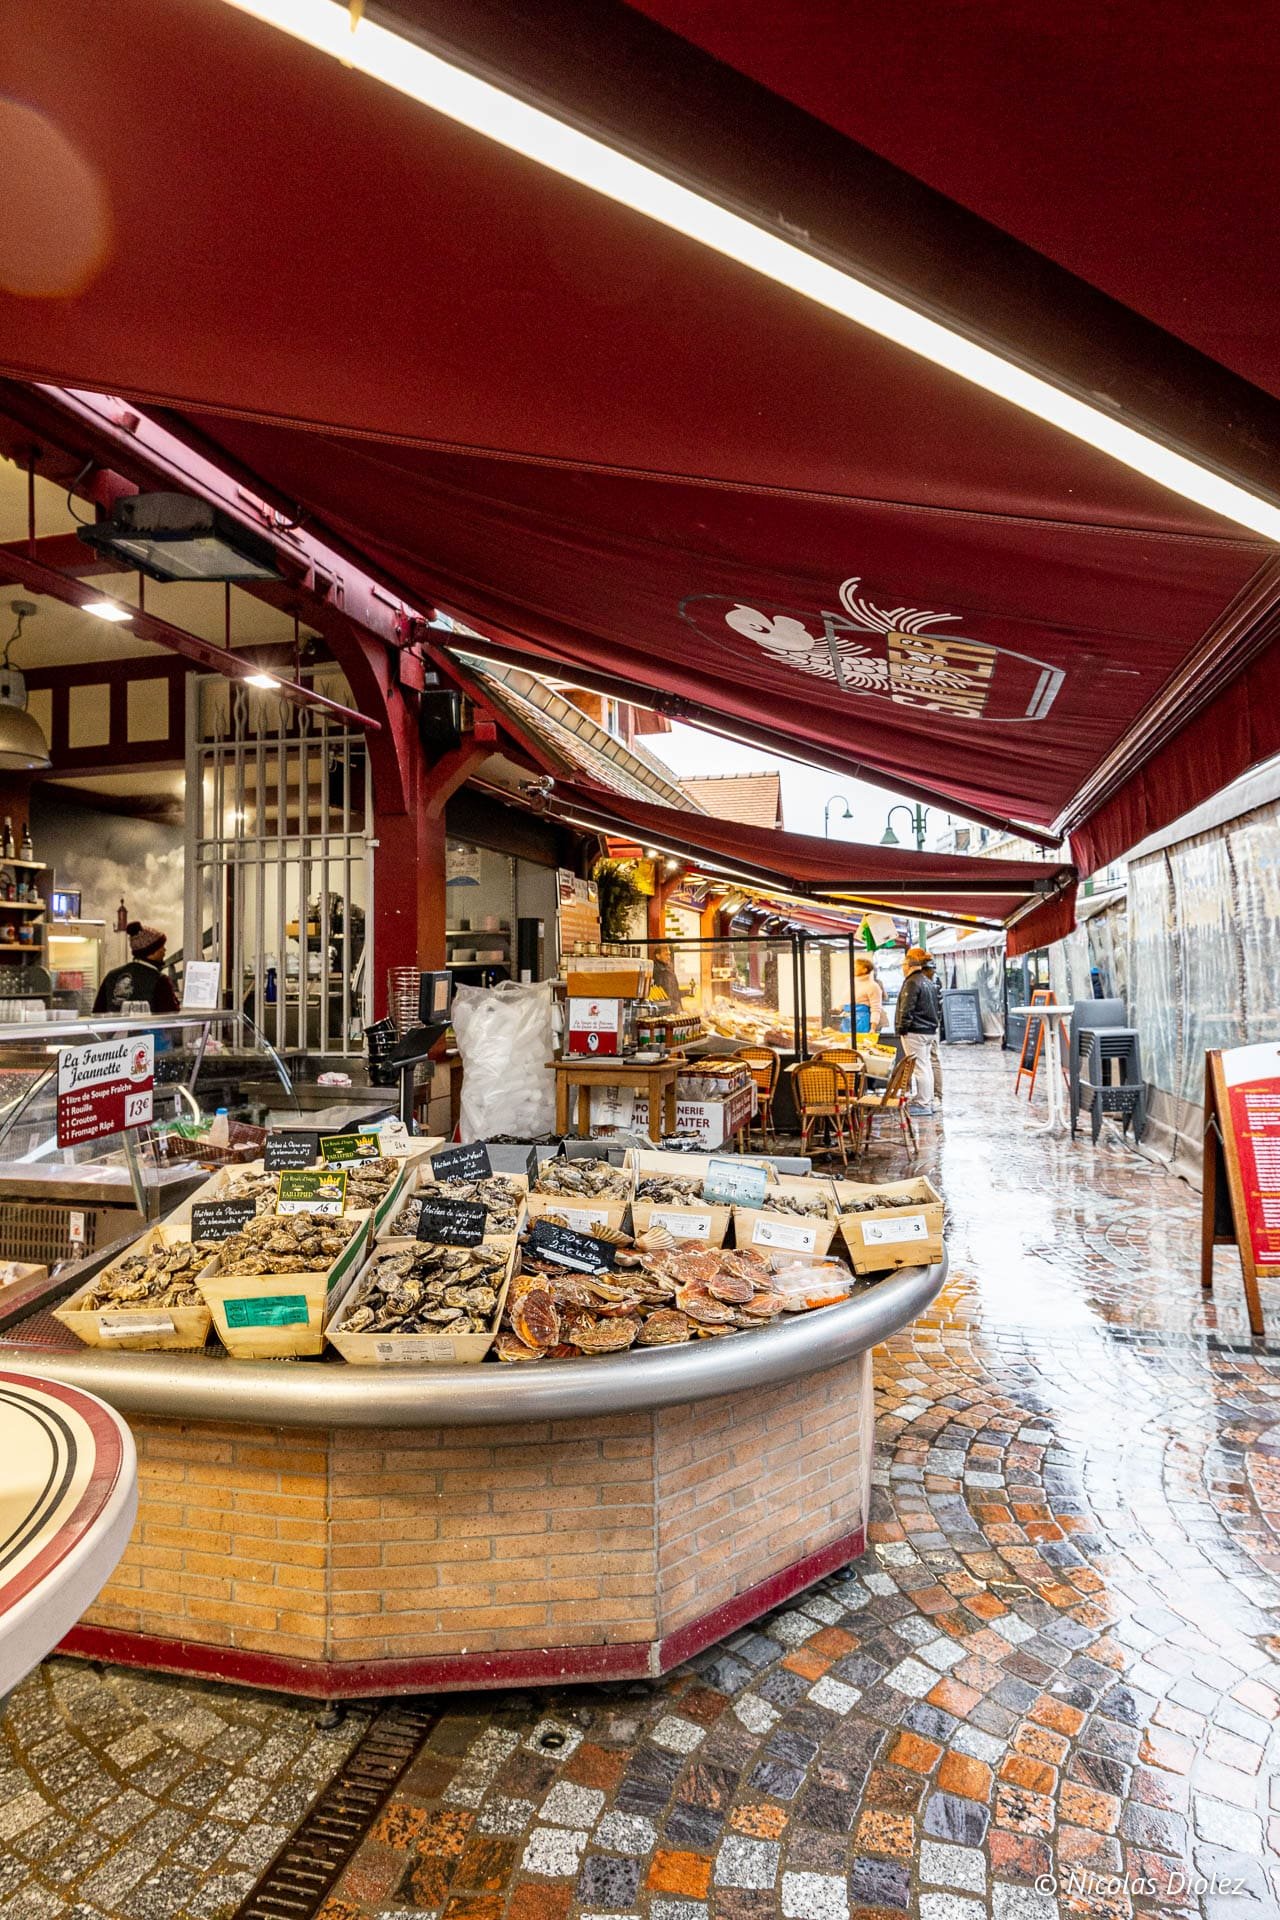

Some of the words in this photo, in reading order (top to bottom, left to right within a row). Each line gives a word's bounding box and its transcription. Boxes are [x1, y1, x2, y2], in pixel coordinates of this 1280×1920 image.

[62, 1053, 79, 1069] La
[82, 1044, 128, 1065] Formule
[69, 1063, 121, 1088] Jeannette
[82, 1092, 90, 1101] de
[91, 1090, 110, 1099] Soupe
[66, 1108, 70, 1116] 1
[71, 1103, 93, 1115] Rouille
[129, 1097, 149, 1117] 13€
[66, 1119, 70, 1128] 1
[676, 1117, 710, 1128] AITER
[66, 1131, 70, 1140] 1
[71, 1126, 98, 1140] Fromage
[803, 1236, 809, 1244] 3
